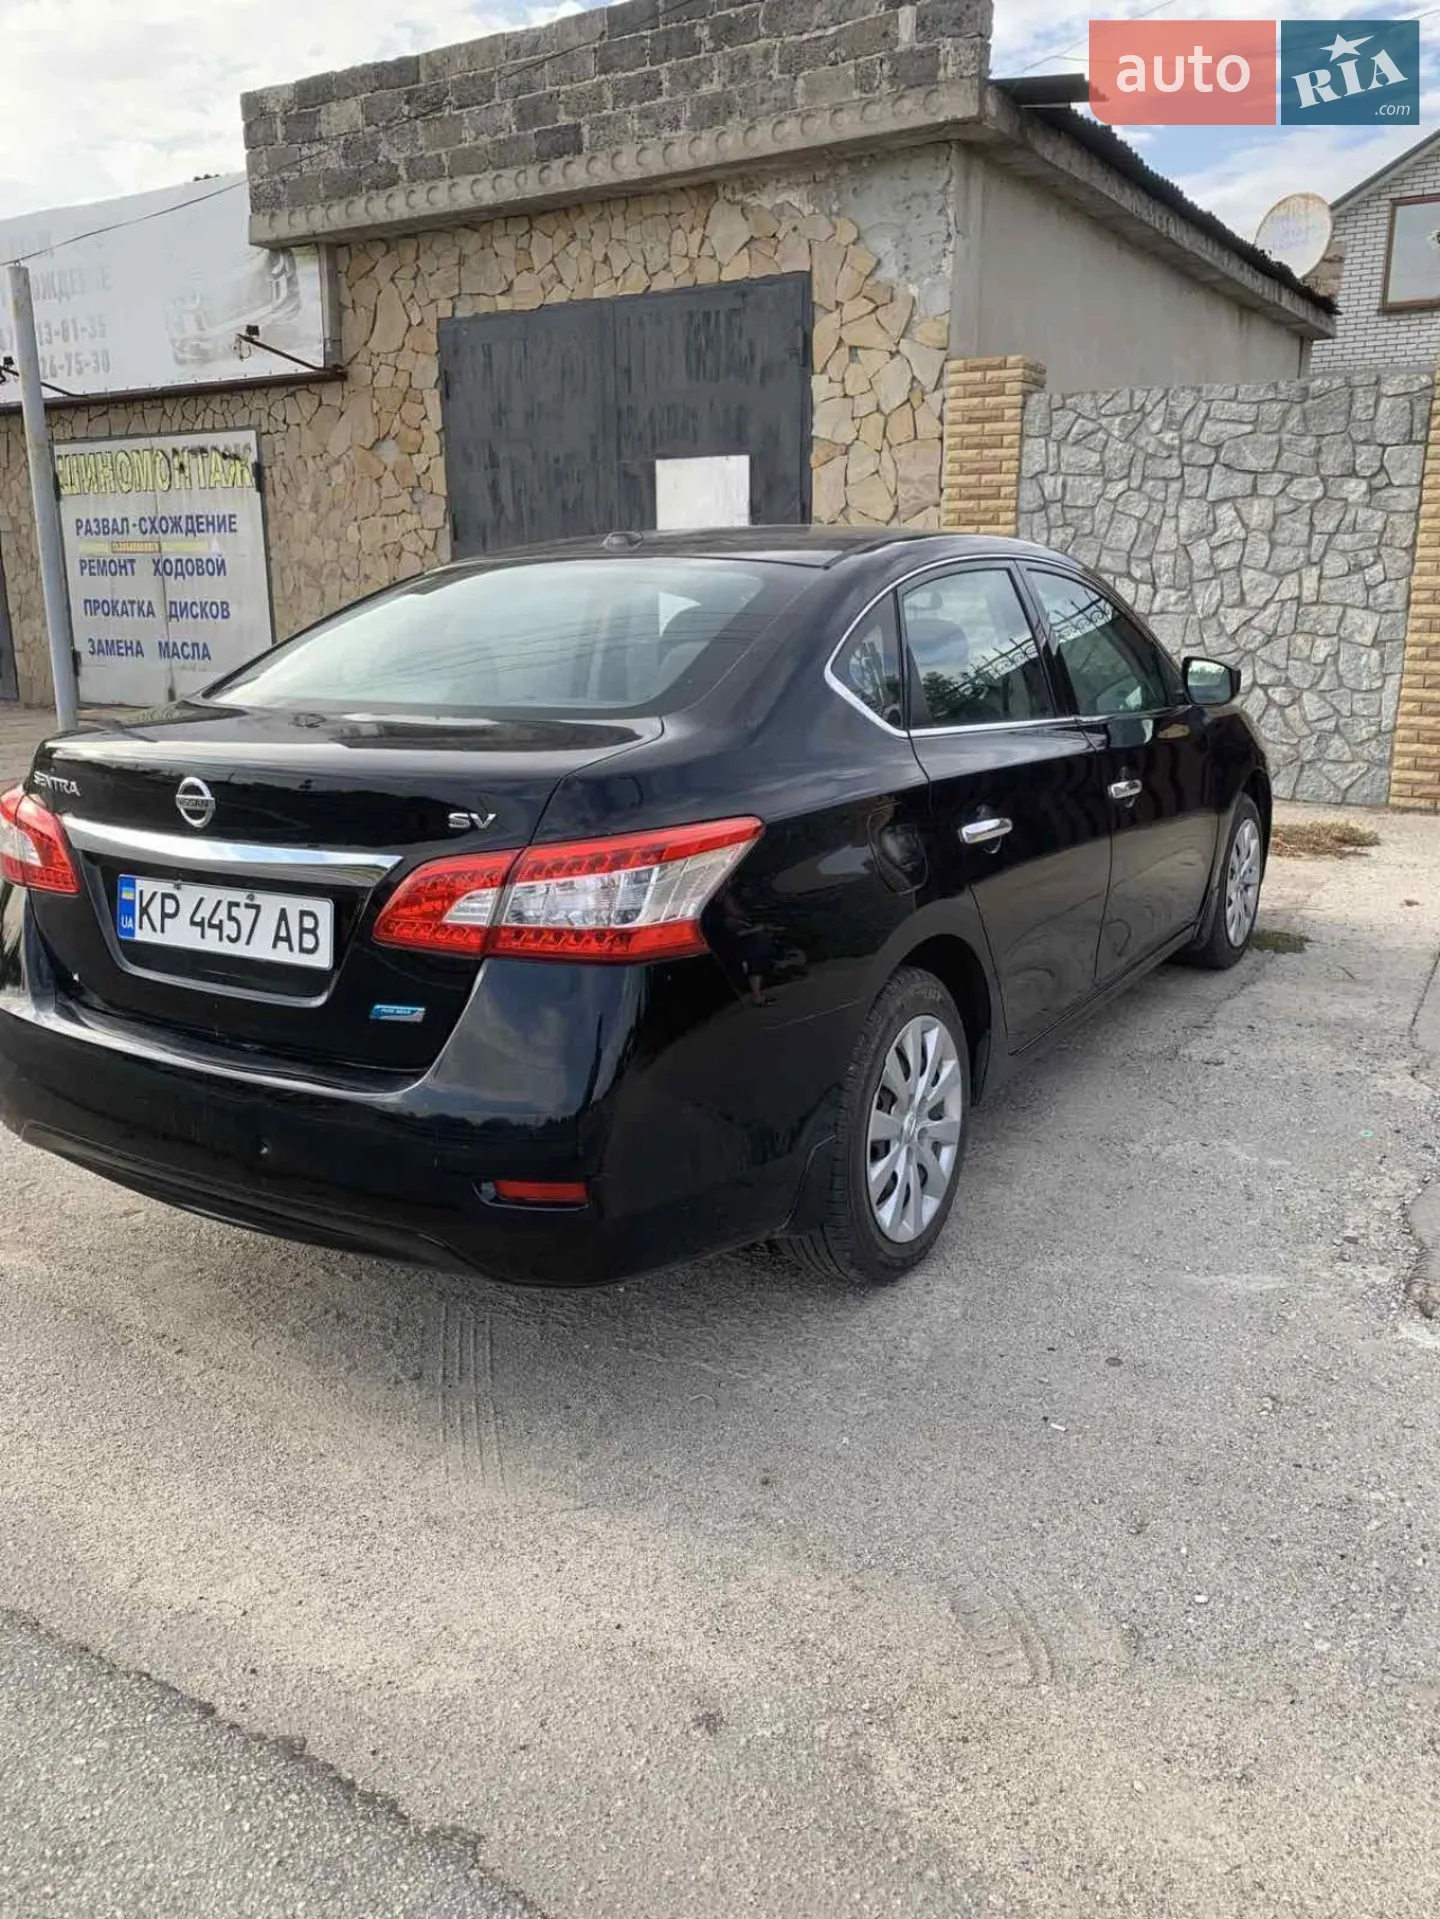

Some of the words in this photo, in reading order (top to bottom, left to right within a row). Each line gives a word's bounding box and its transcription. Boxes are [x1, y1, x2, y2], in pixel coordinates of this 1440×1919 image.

[56, 445, 254, 495] ШИНОМОНТАЖ
[79, 558, 136, 577] РЕМОНТ
[152, 554, 227, 580] ХОДОВОЙ
[83, 598, 156, 618] ПРОКАТКА
[168, 600, 231, 622] ДИСКОВ
[88, 638, 144, 658] ЗАМЕНА
[158, 641, 212, 660] МАСЛА
[448, 813, 497, 829] SV
[121, 916, 134, 929] UA
[138, 890, 180, 934] KP
[189, 897, 261, 946] 4457
[271, 907, 320, 955] AB
